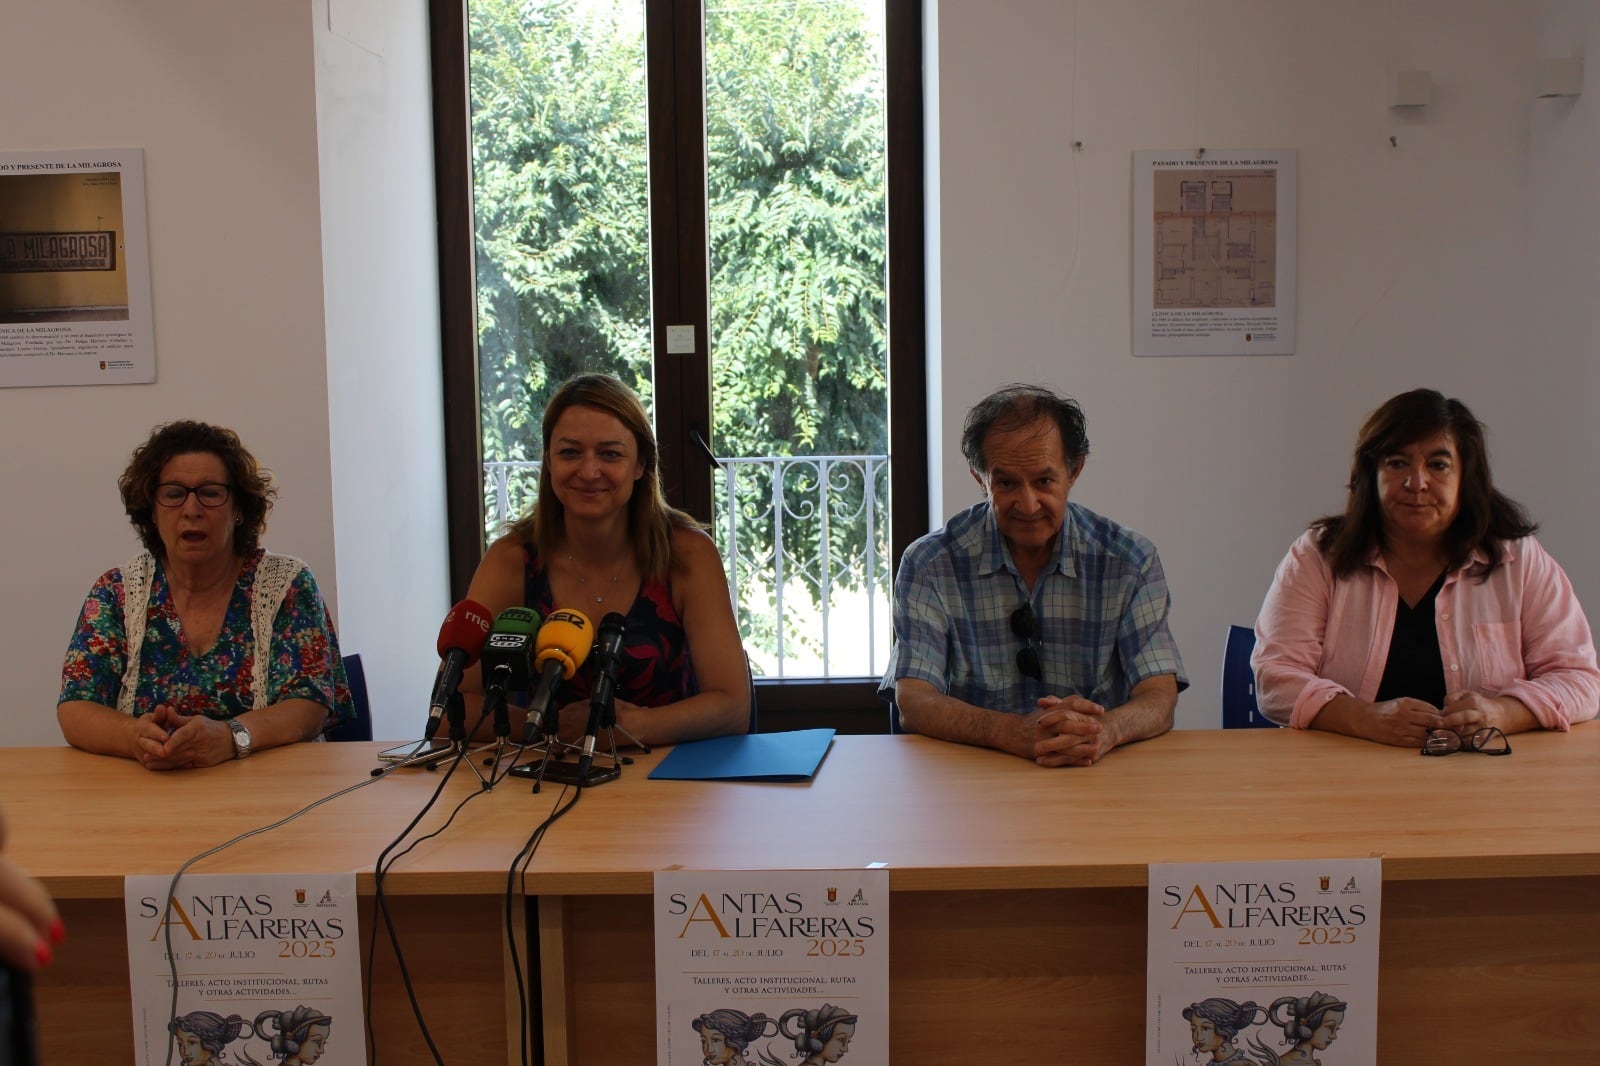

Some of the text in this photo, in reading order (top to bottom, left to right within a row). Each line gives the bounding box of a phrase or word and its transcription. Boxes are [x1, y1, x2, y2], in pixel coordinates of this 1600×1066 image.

[24, 234, 108, 259] MILAGROSA
[465, 610, 490, 633] rne
[1298, 927, 1356, 945] 2025
[806, 939, 865, 957] 2025
[1184, 940, 1201, 948] DEL
[1249, 938, 1275, 946] JULIO
[229, 951, 255, 959] JULIO
[278, 941, 337, 959] 2025
[691, 949, 708, 957] DEL
[757, 949, 783, 957] JULIO
[1184, 966, 1223, 975] TALLERES,
[1321, 963, 1347, 971] RUTAS
[167, 980, 206, 988] TLLERES,
[692, 976, 732, 985] TALLERES,
[734, 977, 757, 985] ACTO
[830, 976, 856, 984] RUTAS
[724, 986, 730, 994] Y
[731, 986, 759, 994] OTRAS
